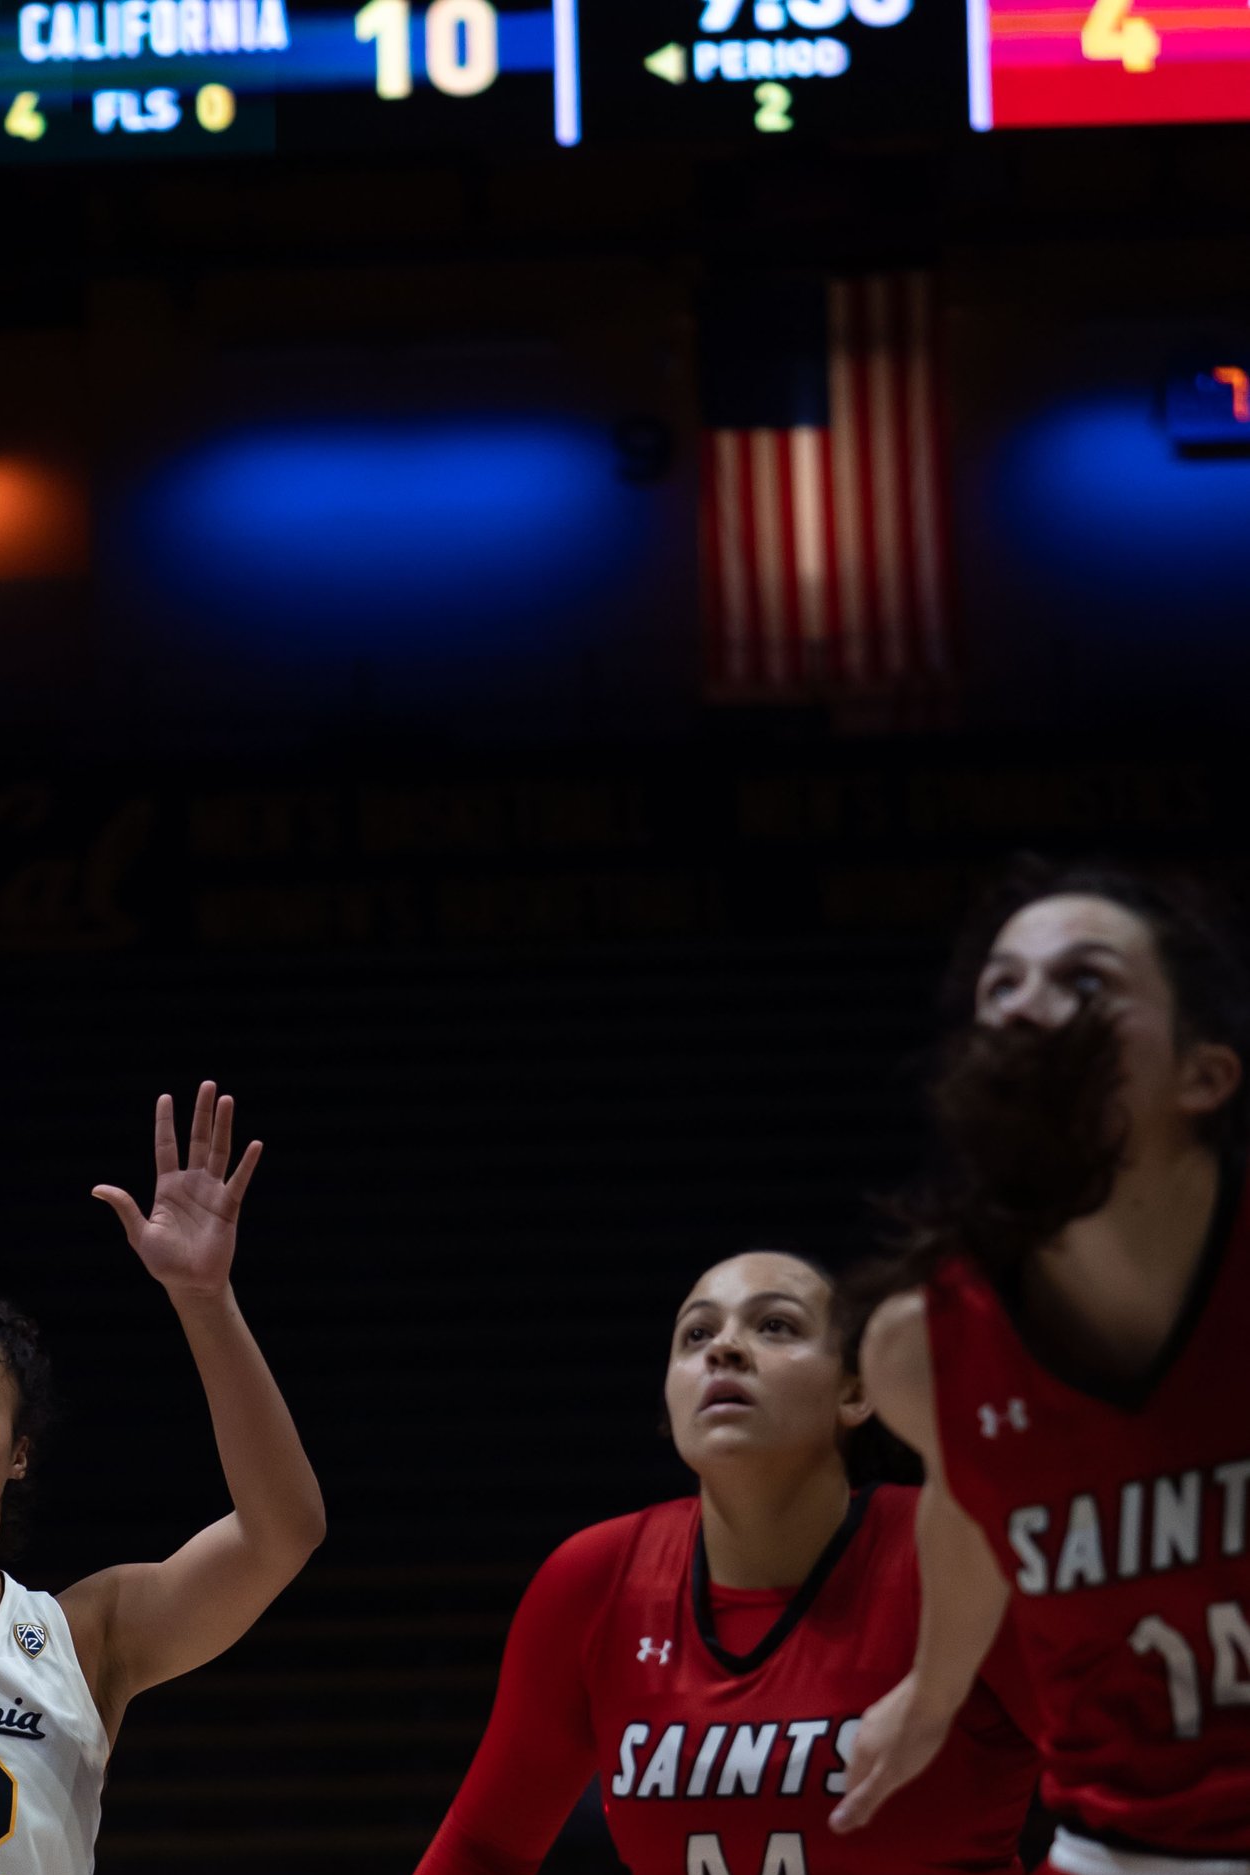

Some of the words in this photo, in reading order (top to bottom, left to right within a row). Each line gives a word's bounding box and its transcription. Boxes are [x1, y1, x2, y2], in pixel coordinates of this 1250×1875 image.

[19, 0, 290, 63] CALIFORNIA
[354, 0, 499, 98] 10
[693, 38, 851, 82] PERIOD
[93, 88, 183, 133] FLS
[196, 83, 236, 133] 0
[754, 82, 794, 133] 2
[17, 1624, 45, 1644] PAC
[24, 1637, 40, 1650] 12
[612, 1718, 862, 1798] SAINTS
